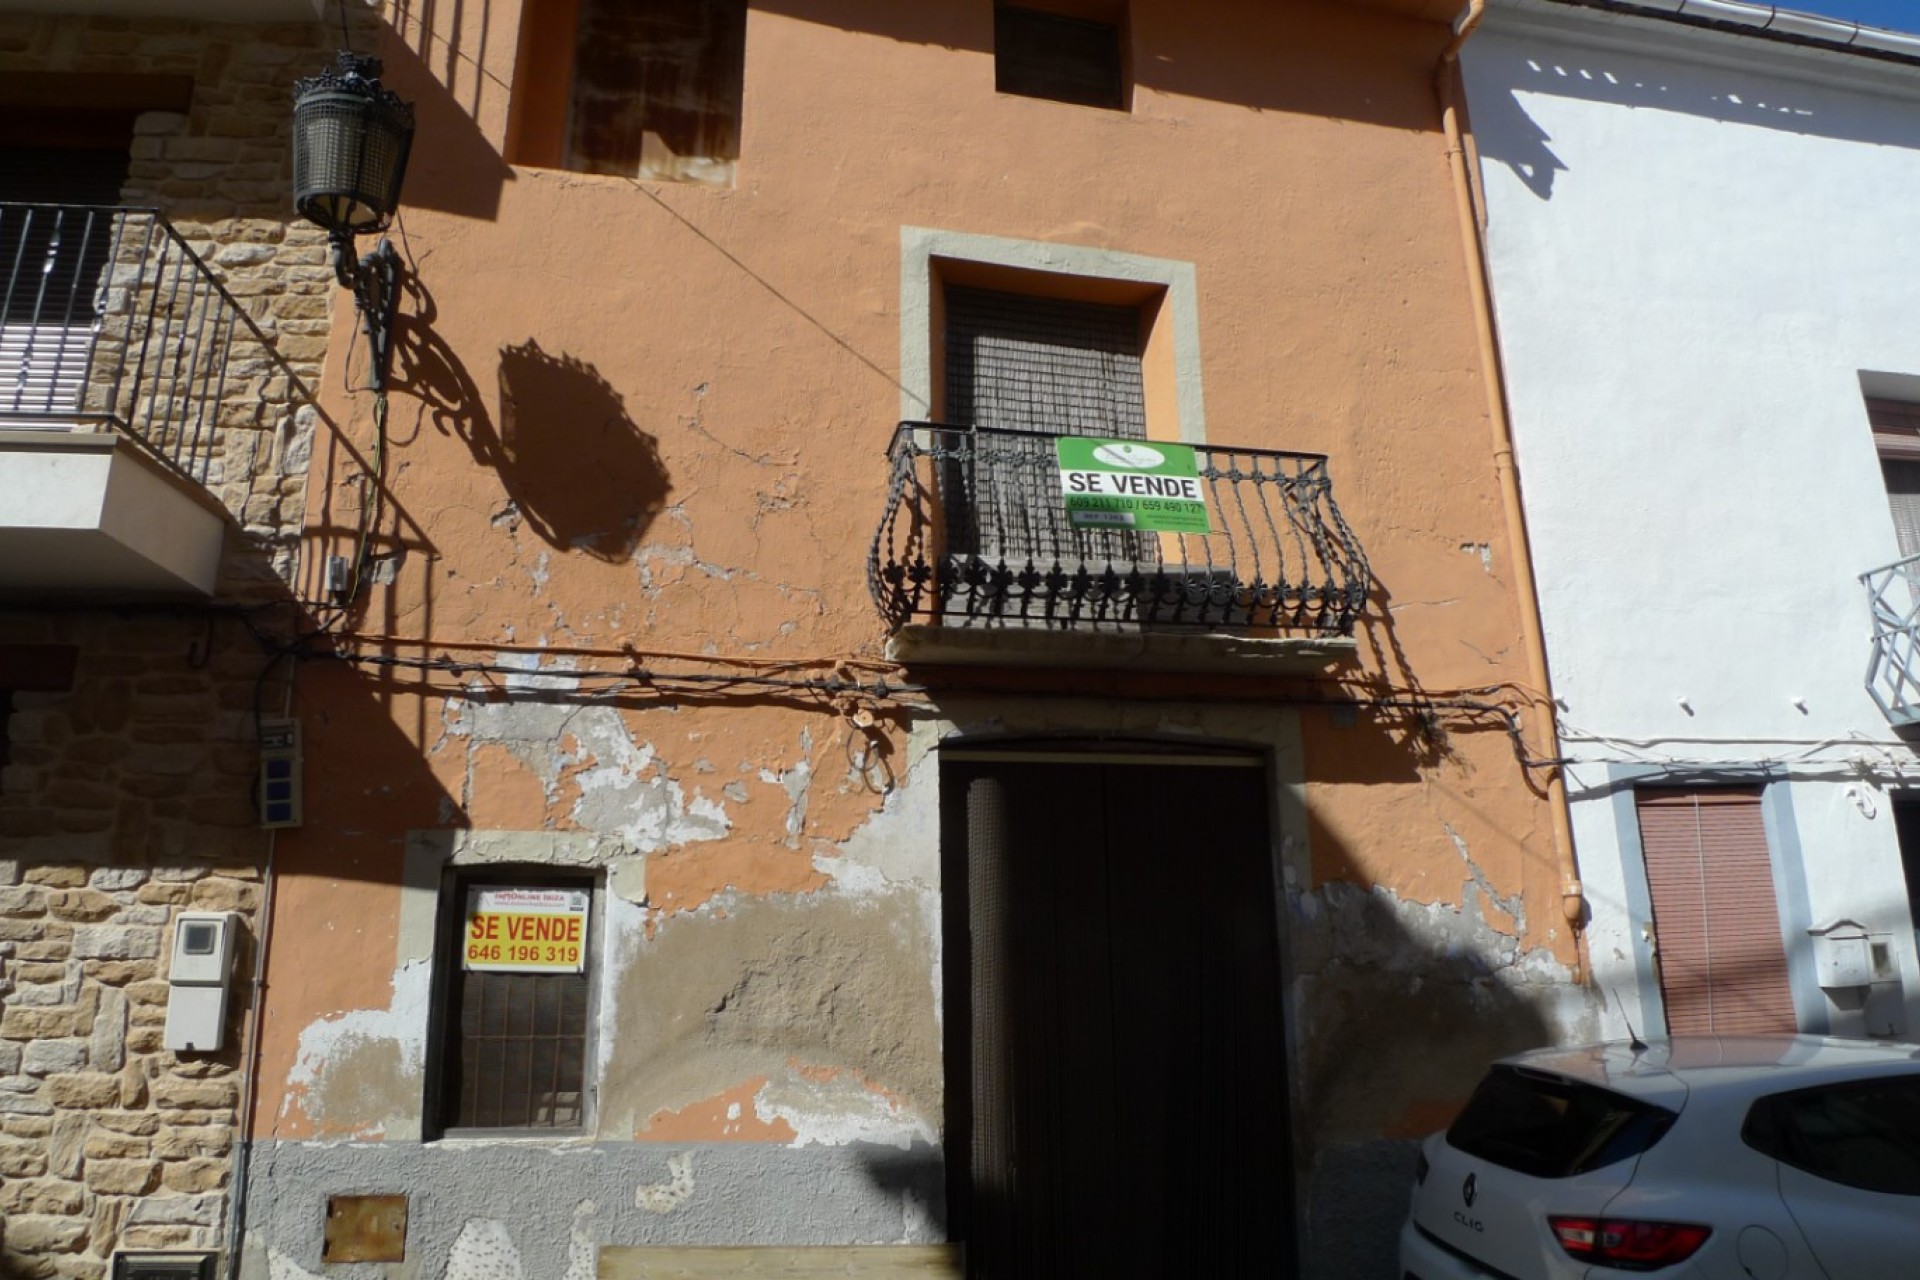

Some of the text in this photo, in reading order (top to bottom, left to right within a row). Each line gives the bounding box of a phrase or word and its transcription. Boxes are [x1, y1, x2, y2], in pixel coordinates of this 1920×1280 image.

[1069, 472, 1197, 498] SE VENDE
[1070, 496, 1089, 507] 609
[1094, 498, 1110, 508] 211
[1114, 499, 1132, 510] 710
[1142, 500, 1161, 511] 659
[1165, 502, 1181, 512] 490
[471, 915, 581, 942] SE VENDE
[468, 944, 578, 962] 646 196 319
[1453, 1210, 1484, 1233] CLIO
